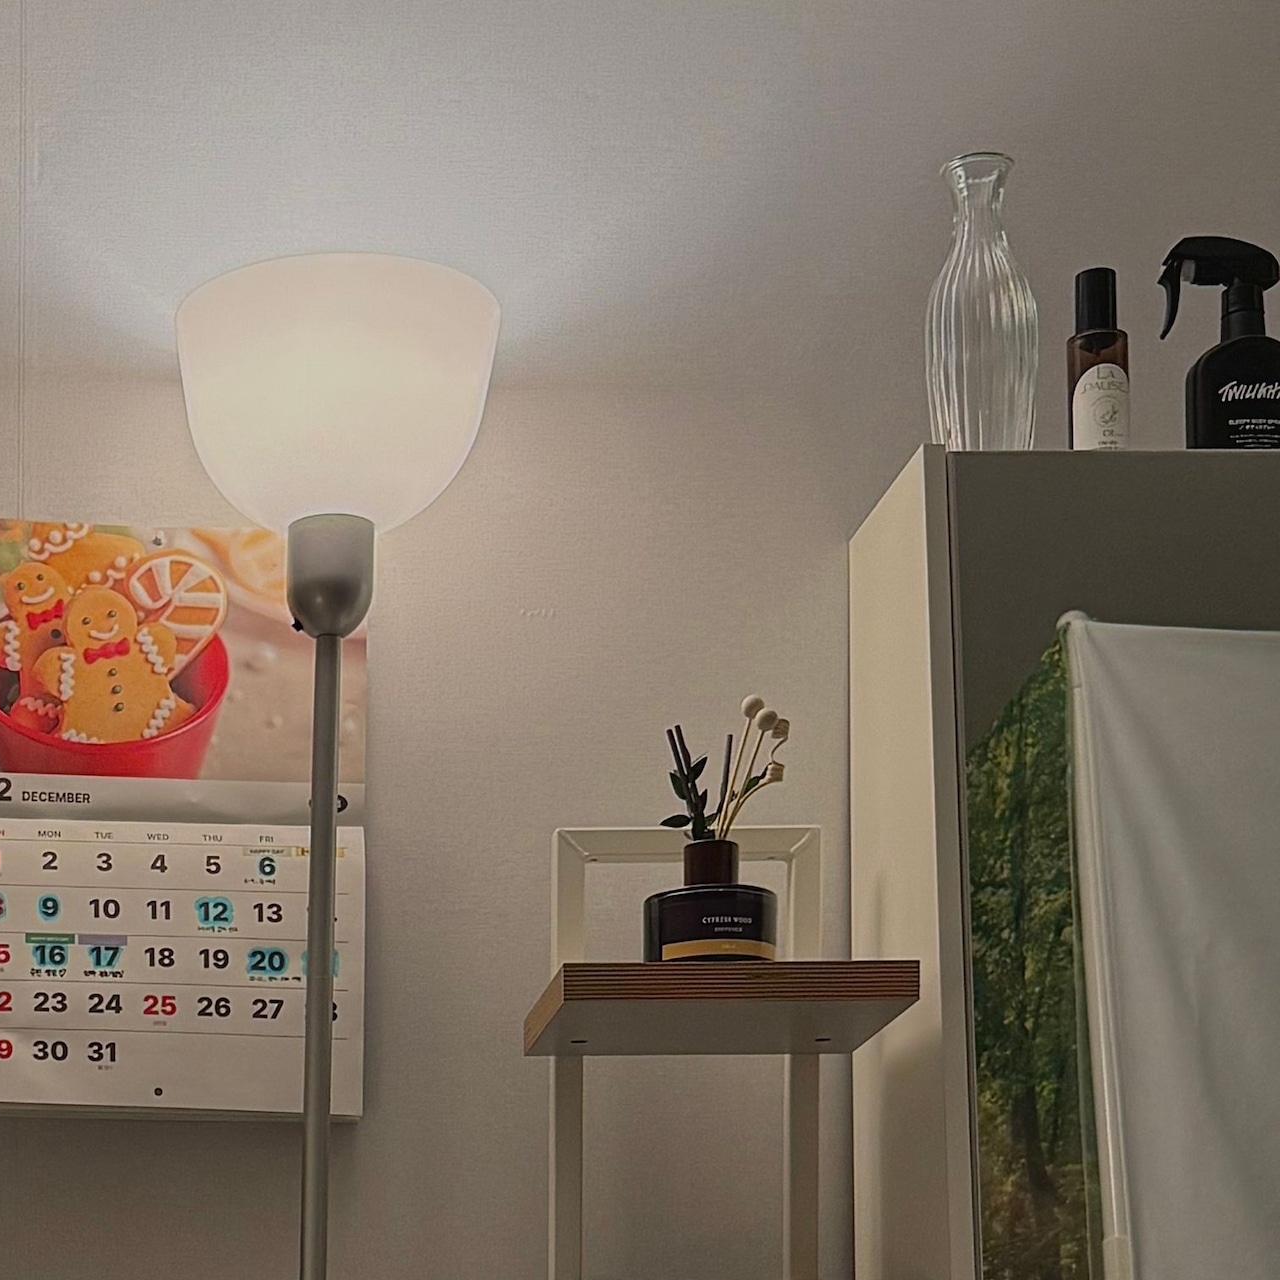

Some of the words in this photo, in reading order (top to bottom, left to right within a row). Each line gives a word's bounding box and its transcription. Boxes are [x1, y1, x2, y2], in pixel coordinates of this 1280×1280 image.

[1097, 367, 1115, 379] LA
[21, 790, 91, 804] DECEMBER
[37, 830, 61, 838] MON
[94, 831, 114, 840] TUE
[146, 833, 170, 841] WED
[202, 834, 223, 843] THU
[259, 835, 274, 843] FRI
[43, 852, 57, 870] 2
[97, 853, 112, 871] 3
[151, 855, 167, 872] 4
[206, 856, 221, 874] 5
[260, 857, 275, 875] 6
[43, 898, 58, 916] 9
[90, 899, 120, 918] 10
[147, 901, 170, 919] 11
[200, 902, 228, 921] 12
[254, 903, 282, 922] 13
[35, 946, 66, 965] 16
[91, 947, 119, 966] 17
[145, 948, 174, 967] 18
[200, 949, 228, 968] 19
[251, 951, 284, 971] 20
[34, 992, 67, 1012] 23
[89, 994, 122, 1013] 24
[144, 995, 176, 1015] 25
[198, 997, 230, 1017] 26
[253, 999, 283, 1019] 27
[33, 1041, 68, 1060] 30
[88, 1042, 115, 1062] 31
